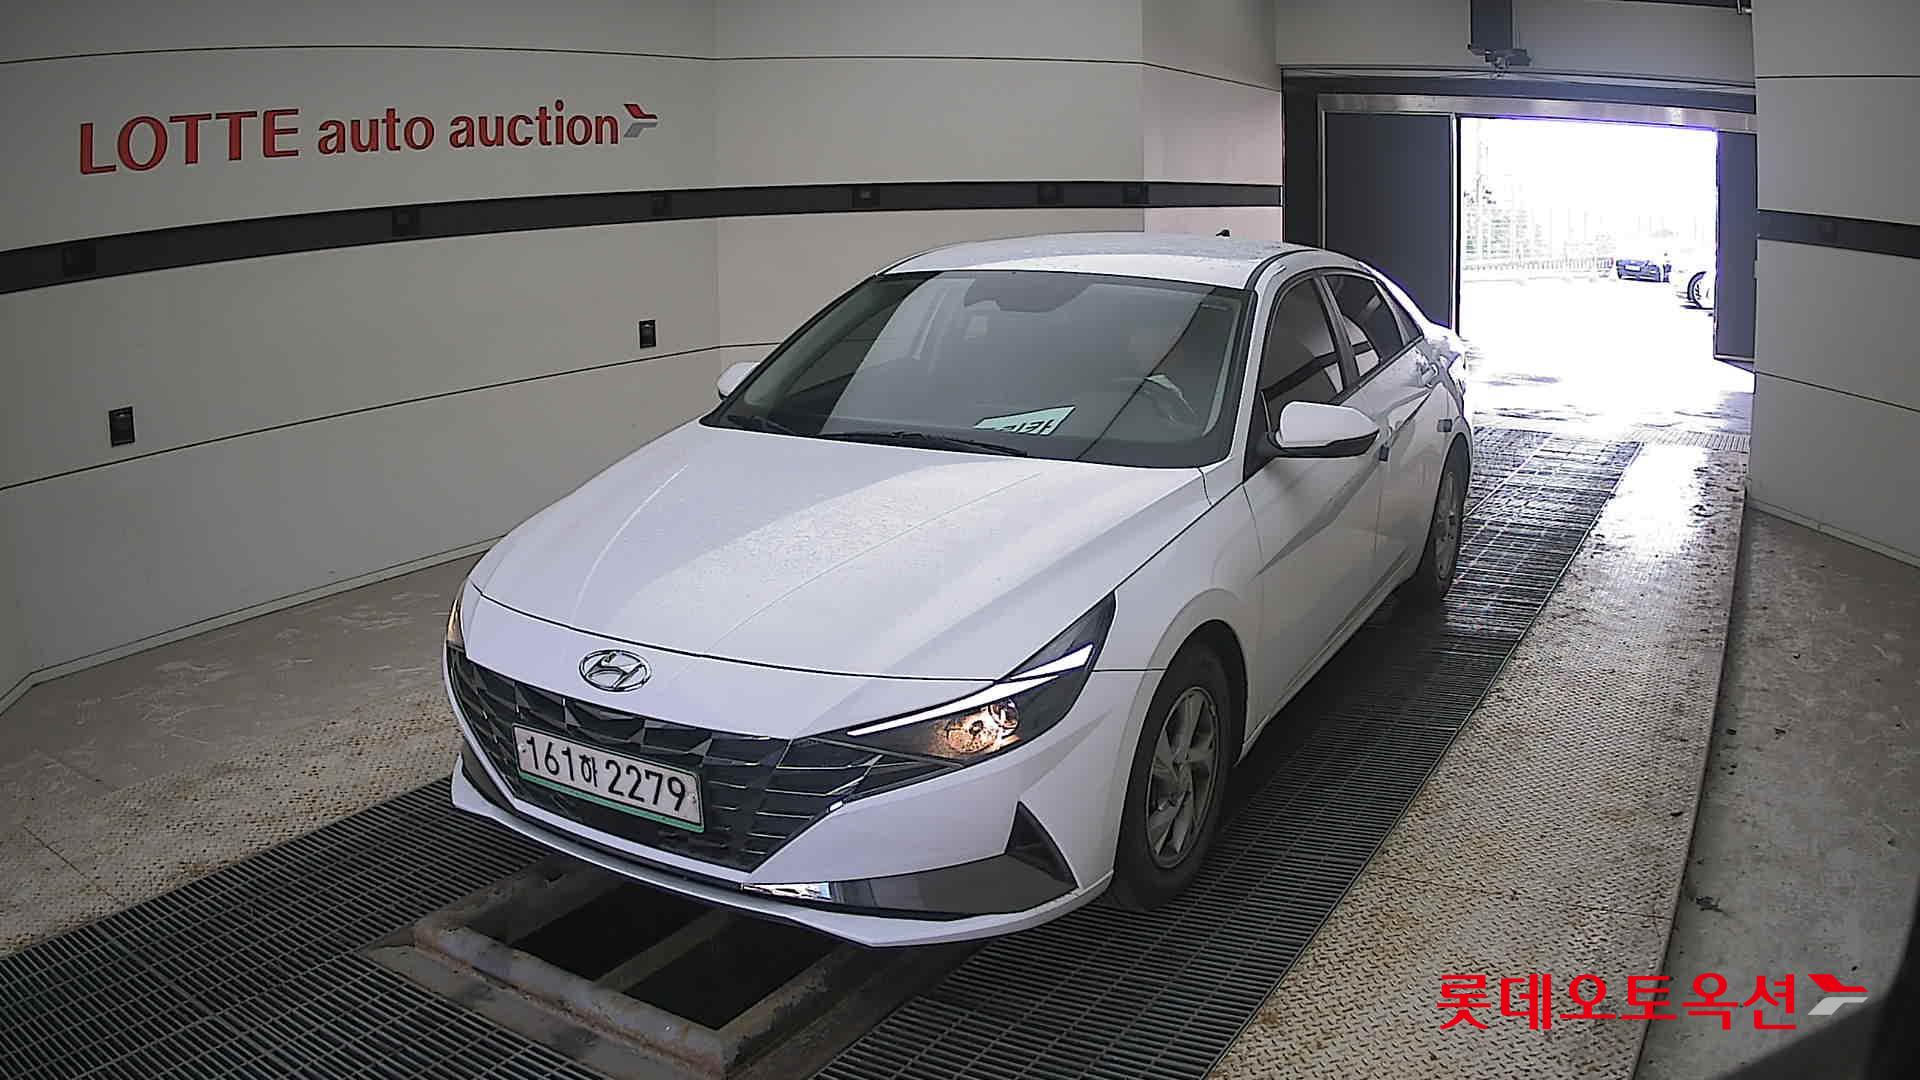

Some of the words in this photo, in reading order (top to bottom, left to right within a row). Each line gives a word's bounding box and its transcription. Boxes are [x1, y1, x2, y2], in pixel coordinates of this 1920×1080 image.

[79, 108, 300, 175] LOTTE
[317, 107, 435, 154] auto
[448, 100, 620, 149] auction
